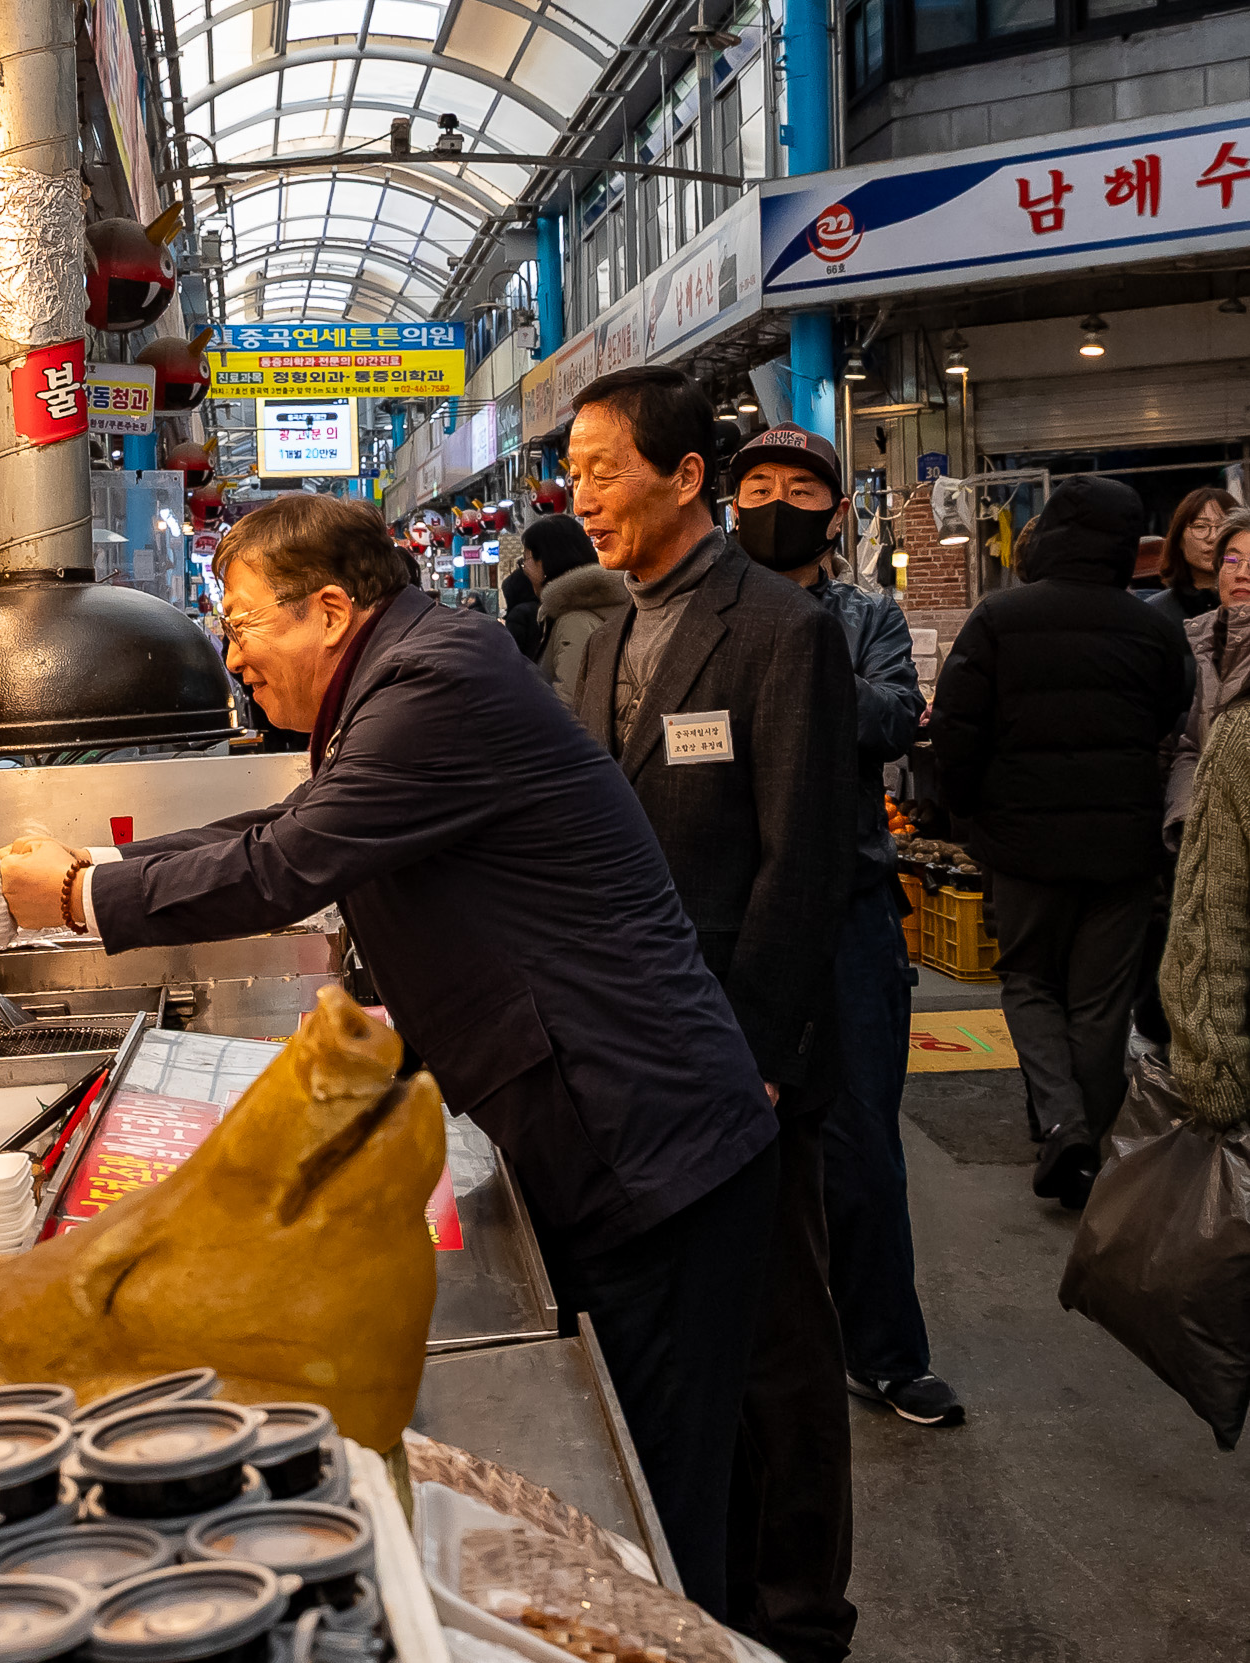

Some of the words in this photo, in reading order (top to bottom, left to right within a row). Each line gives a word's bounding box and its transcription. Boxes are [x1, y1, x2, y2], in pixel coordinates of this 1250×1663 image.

[826, 263, 847, 275] 66호
[218, 372, 263, 384] 진료과목
[355, 370, 444, 383] 통증의학과
[35, 361, 81, 419] 불
[401, 385, 450, 393] 02-461-7582
[765, 431, 796, 441] QUIK
[926, 466, 940, 479] 30
